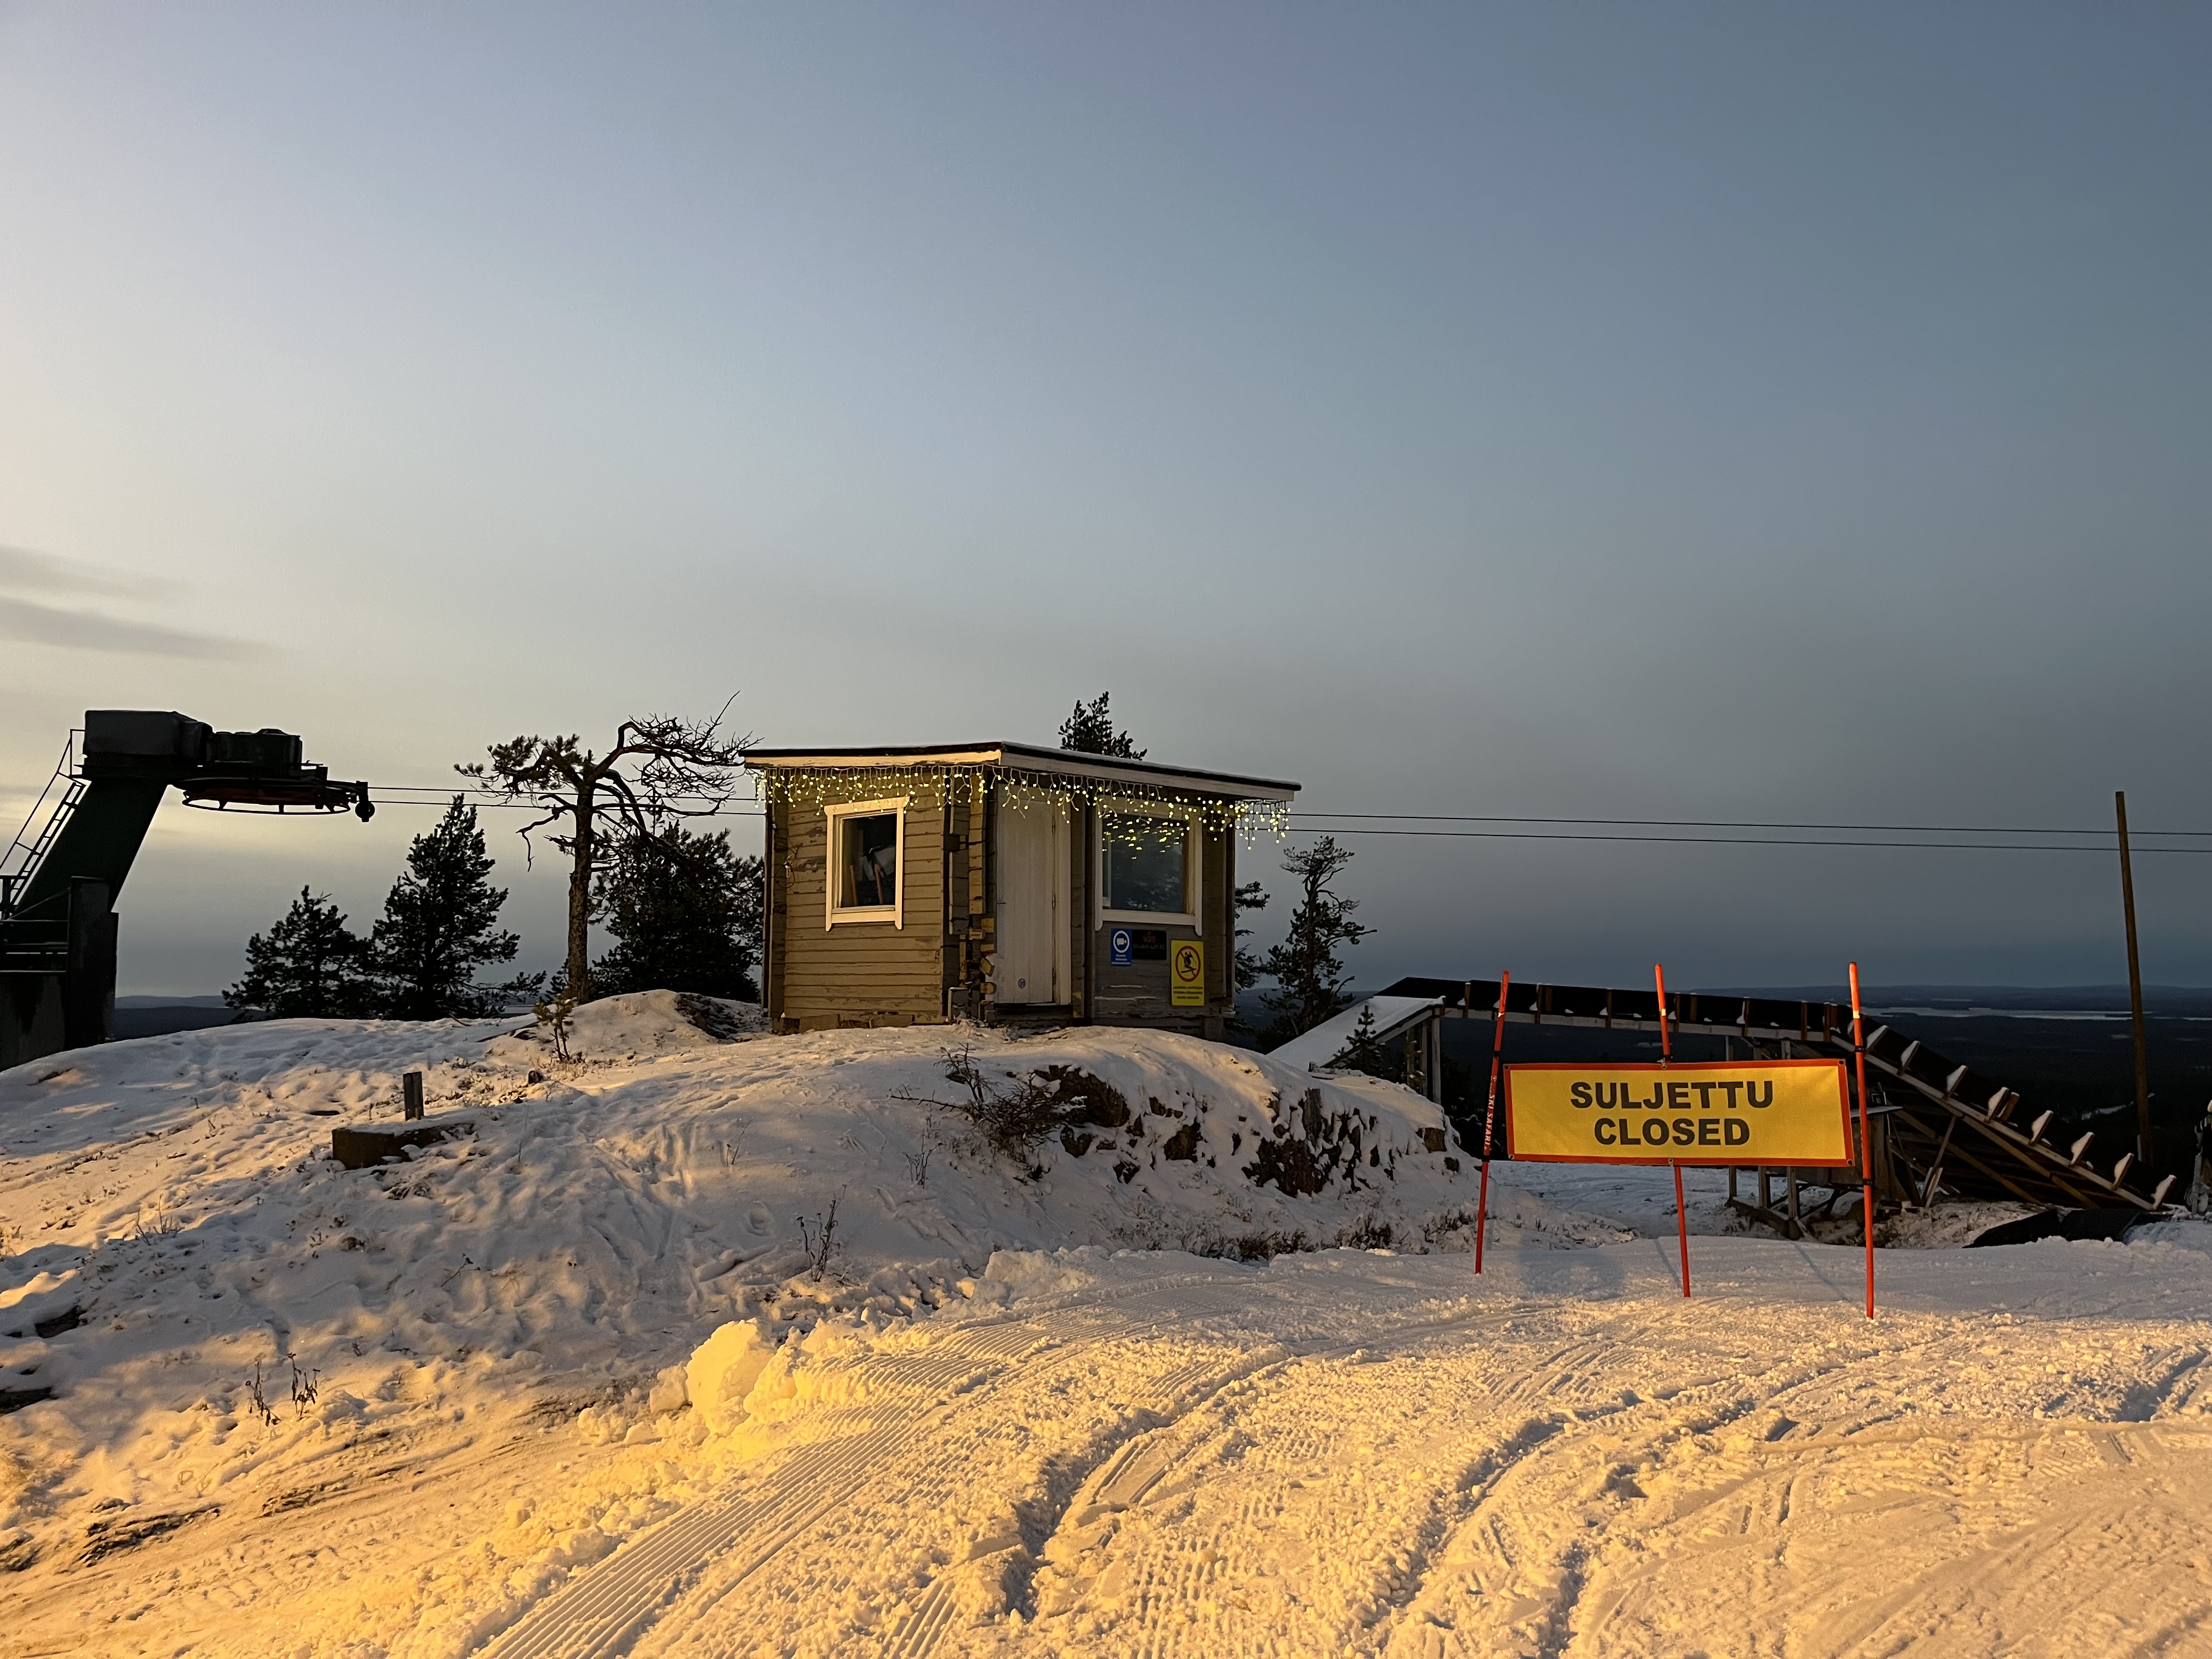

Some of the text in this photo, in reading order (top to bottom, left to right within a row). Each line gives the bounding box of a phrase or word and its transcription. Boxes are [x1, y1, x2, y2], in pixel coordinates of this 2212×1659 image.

[1570, 1081, 1773, 1109] SULJETTU
[1484, 1112, 1493, 1146] SAFARI
[1594, 1118, 1750, 1146] CLOSED
